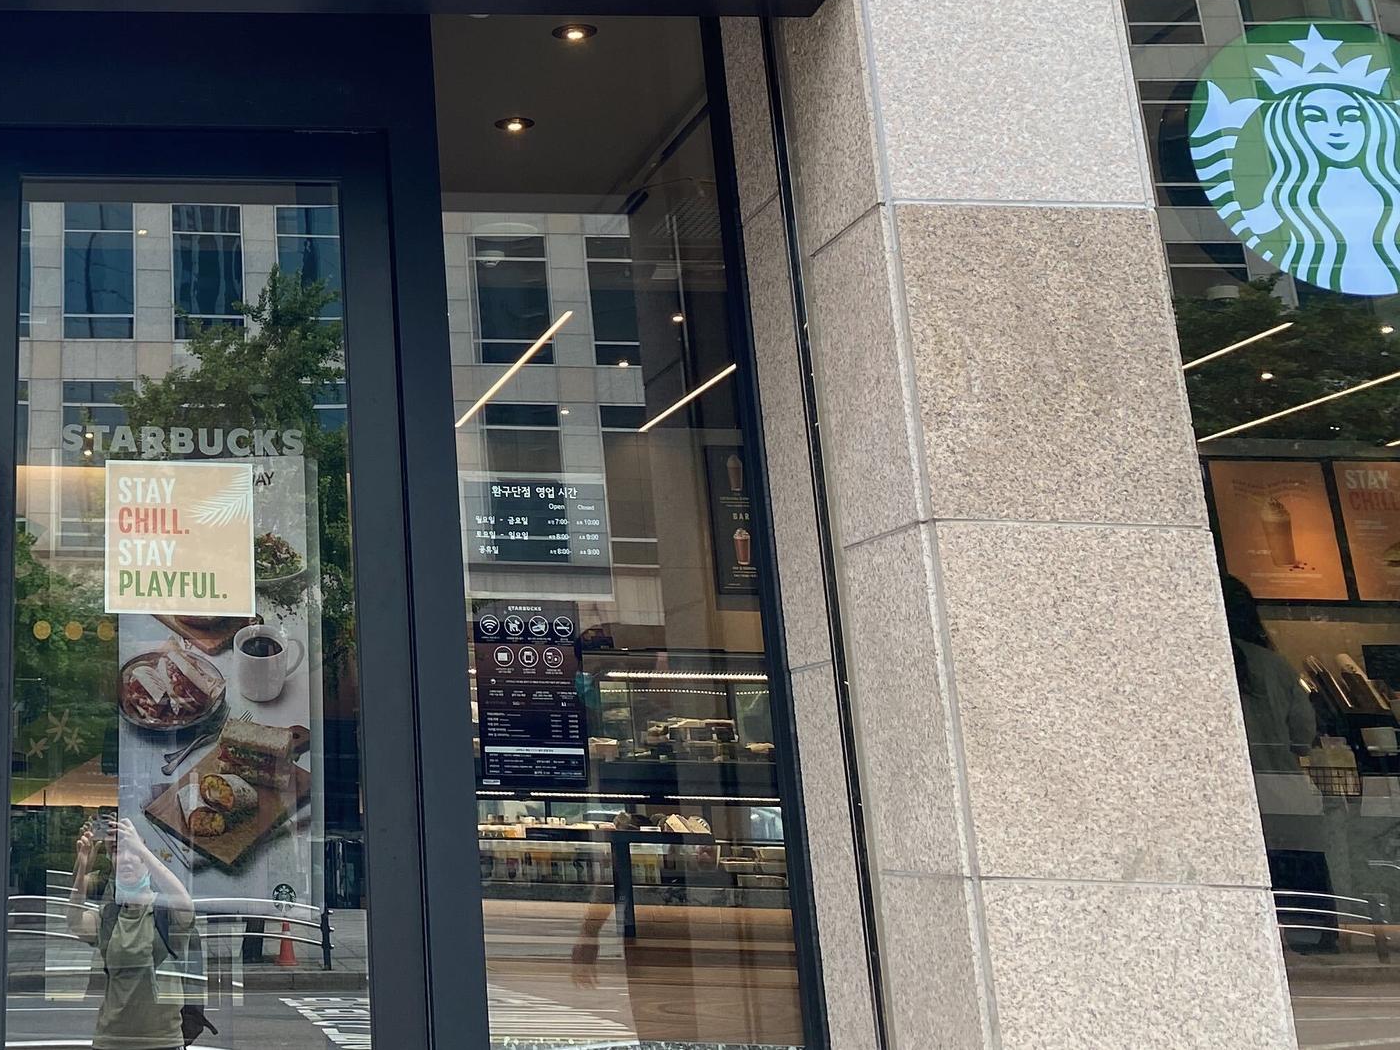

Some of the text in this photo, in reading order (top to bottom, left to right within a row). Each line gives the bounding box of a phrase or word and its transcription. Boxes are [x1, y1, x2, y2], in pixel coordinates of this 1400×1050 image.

[62, 423, 305, 457] STARBUCKS
[118, 476, 176, 504] STAY
[491, 485, 578, 499] 환구단점 영업 시간
[118, 506, 191, 535] CHILL.
[507, 516, 529, 526] 금요일
[548, 503, 566, 511] Open
[508, 531, 529, 540] 일요일
[118, 538, 177, 567] STAY
[118, 569, 228, 599] PLAYFUL.
